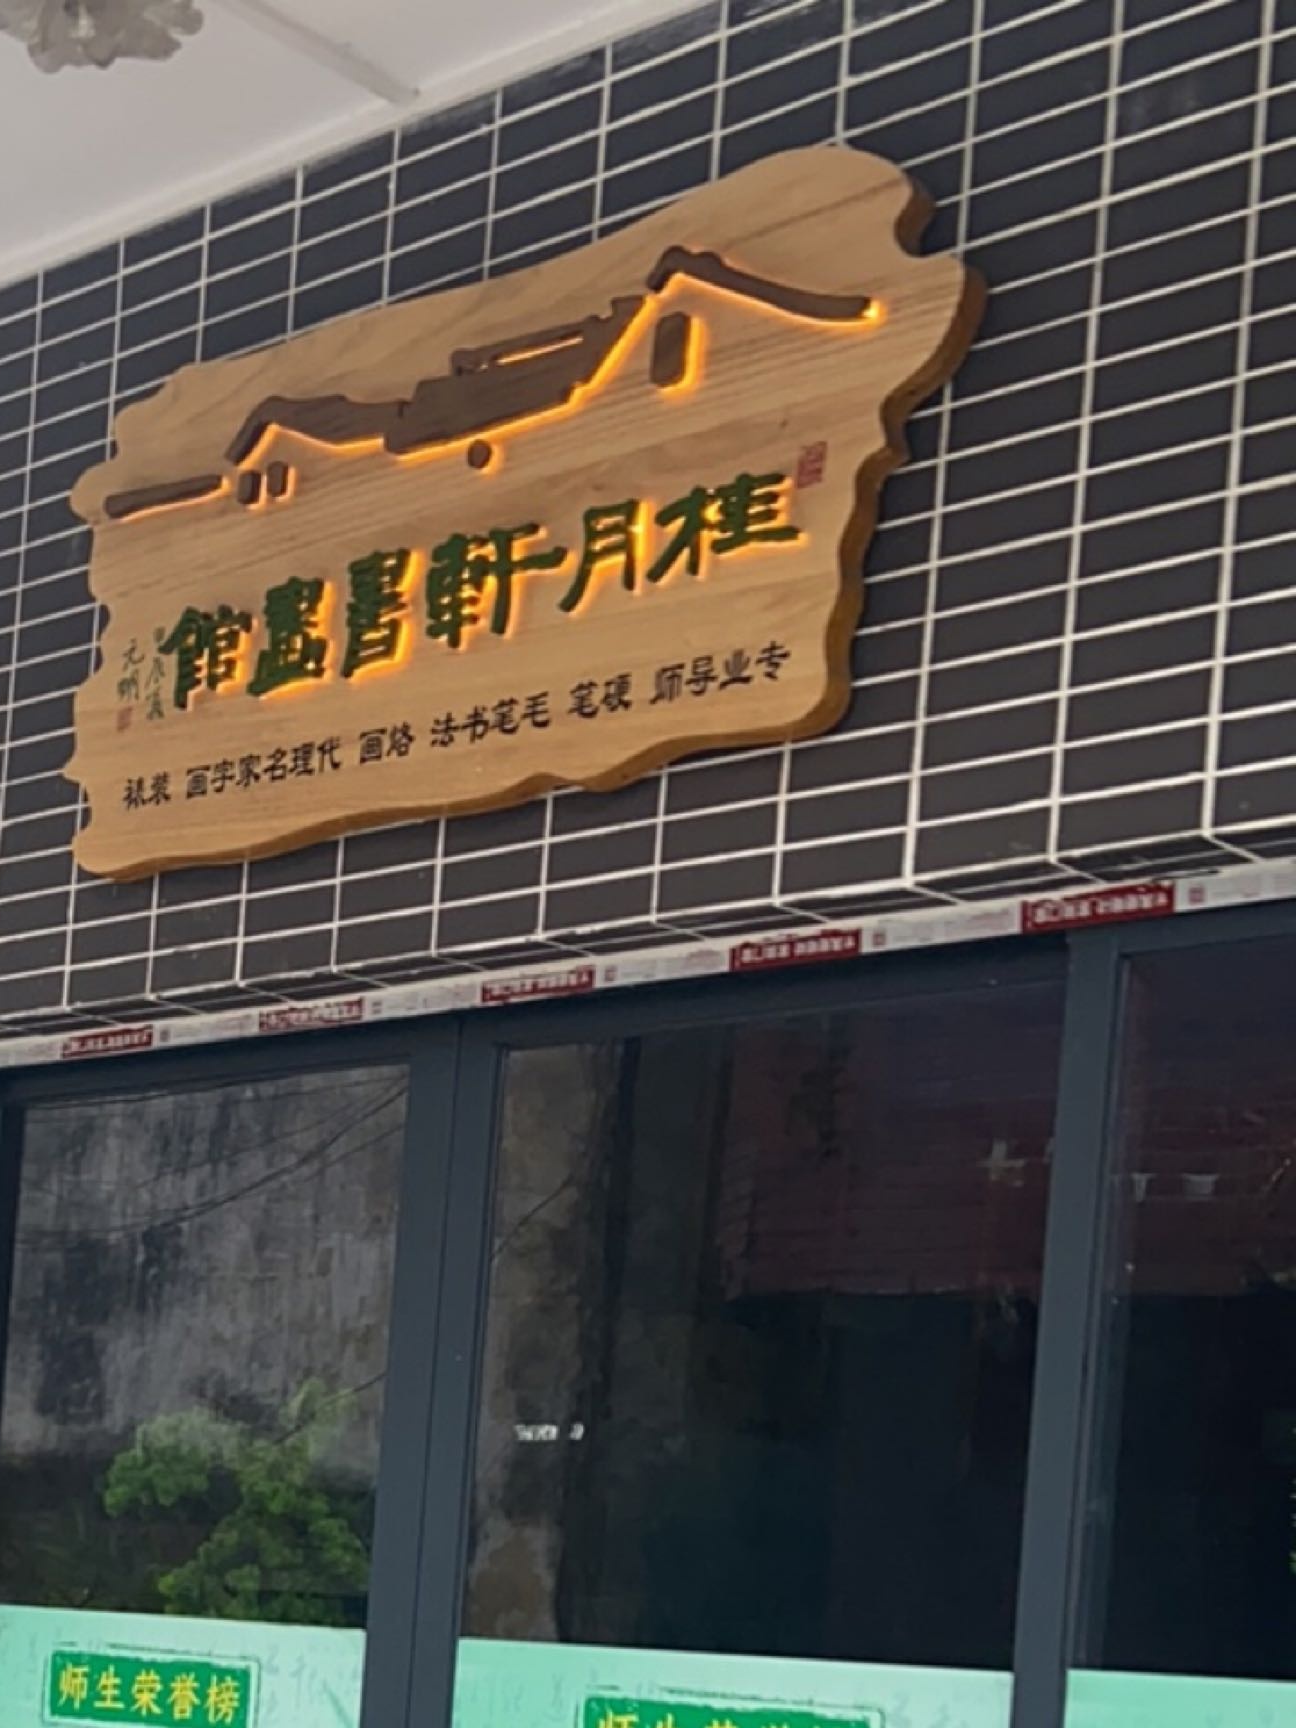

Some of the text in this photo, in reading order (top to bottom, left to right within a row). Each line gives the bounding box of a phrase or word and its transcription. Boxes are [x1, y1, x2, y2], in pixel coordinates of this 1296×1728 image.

[57, 1661, 241, 1725] 师生荣誉榜
